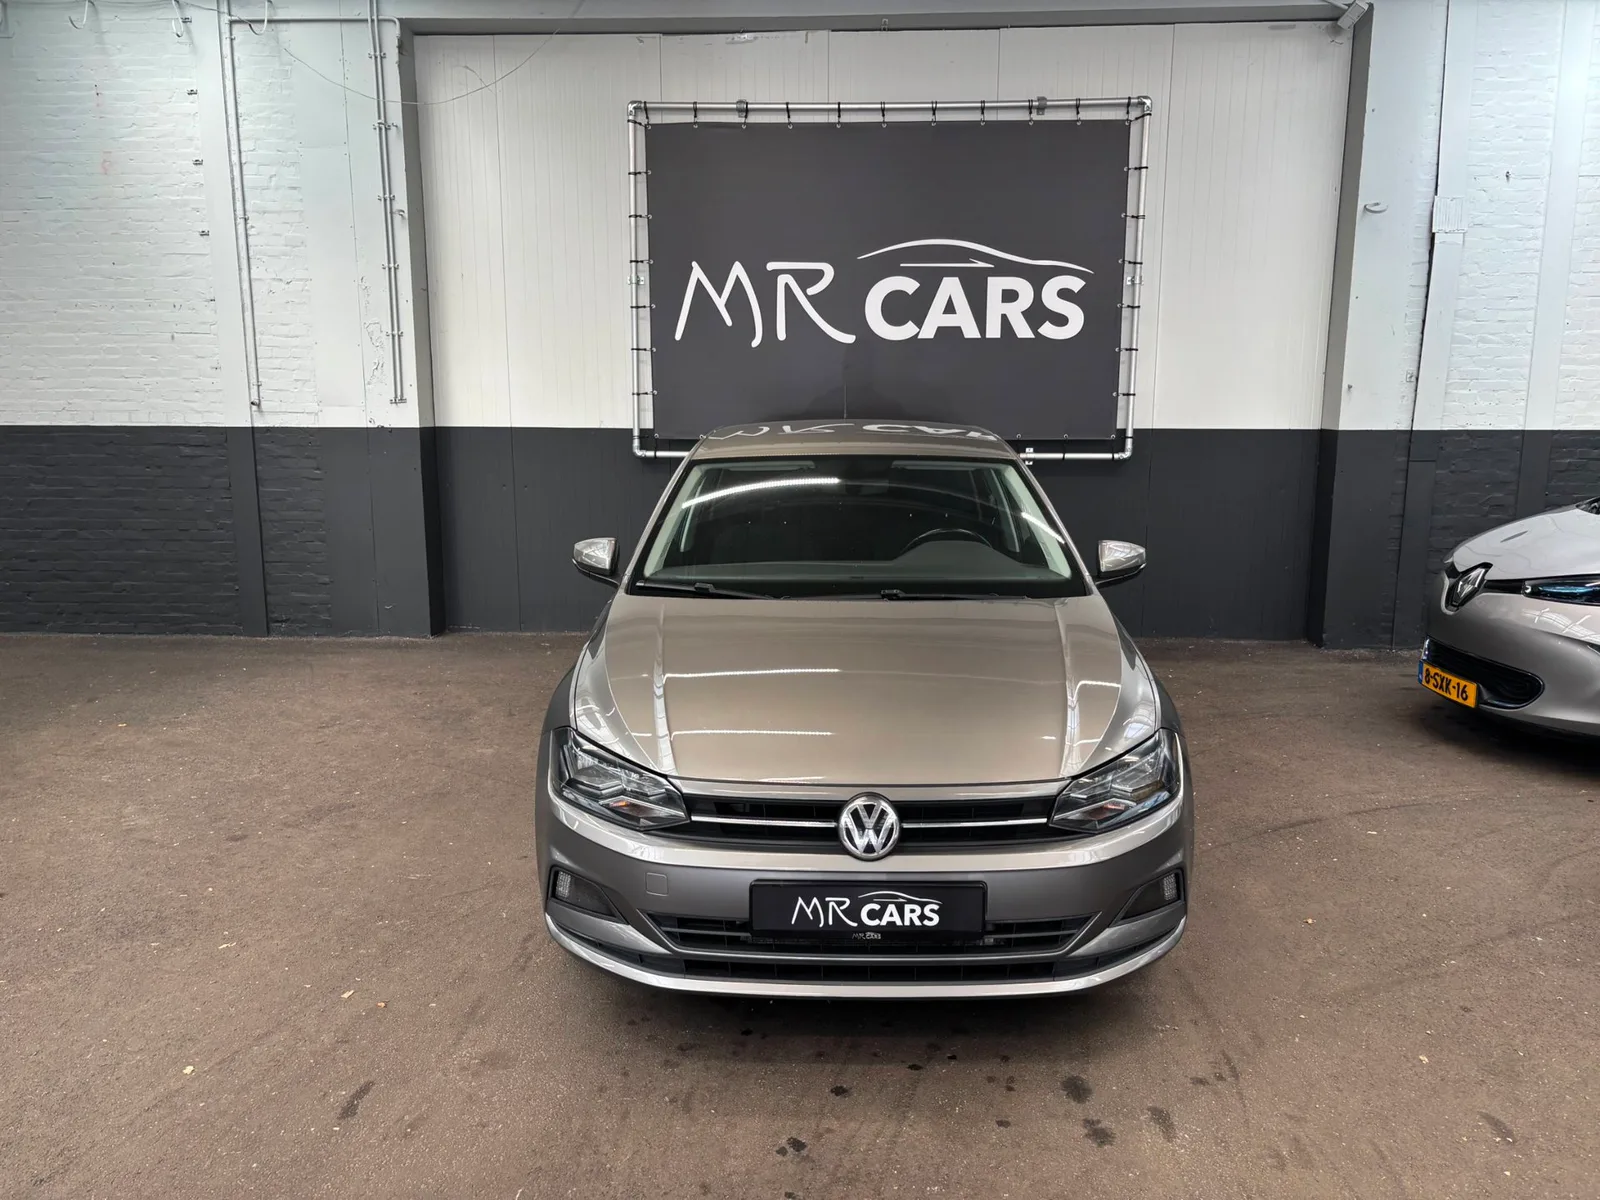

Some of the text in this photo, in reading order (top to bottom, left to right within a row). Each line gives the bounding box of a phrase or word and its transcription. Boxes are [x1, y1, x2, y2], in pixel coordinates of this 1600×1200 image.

[675, 261, 1086, 347] MR CARS
[1424, 667, 1469, 702] 8-SXK-16
[791, 896, 940, 928] MR CARS
